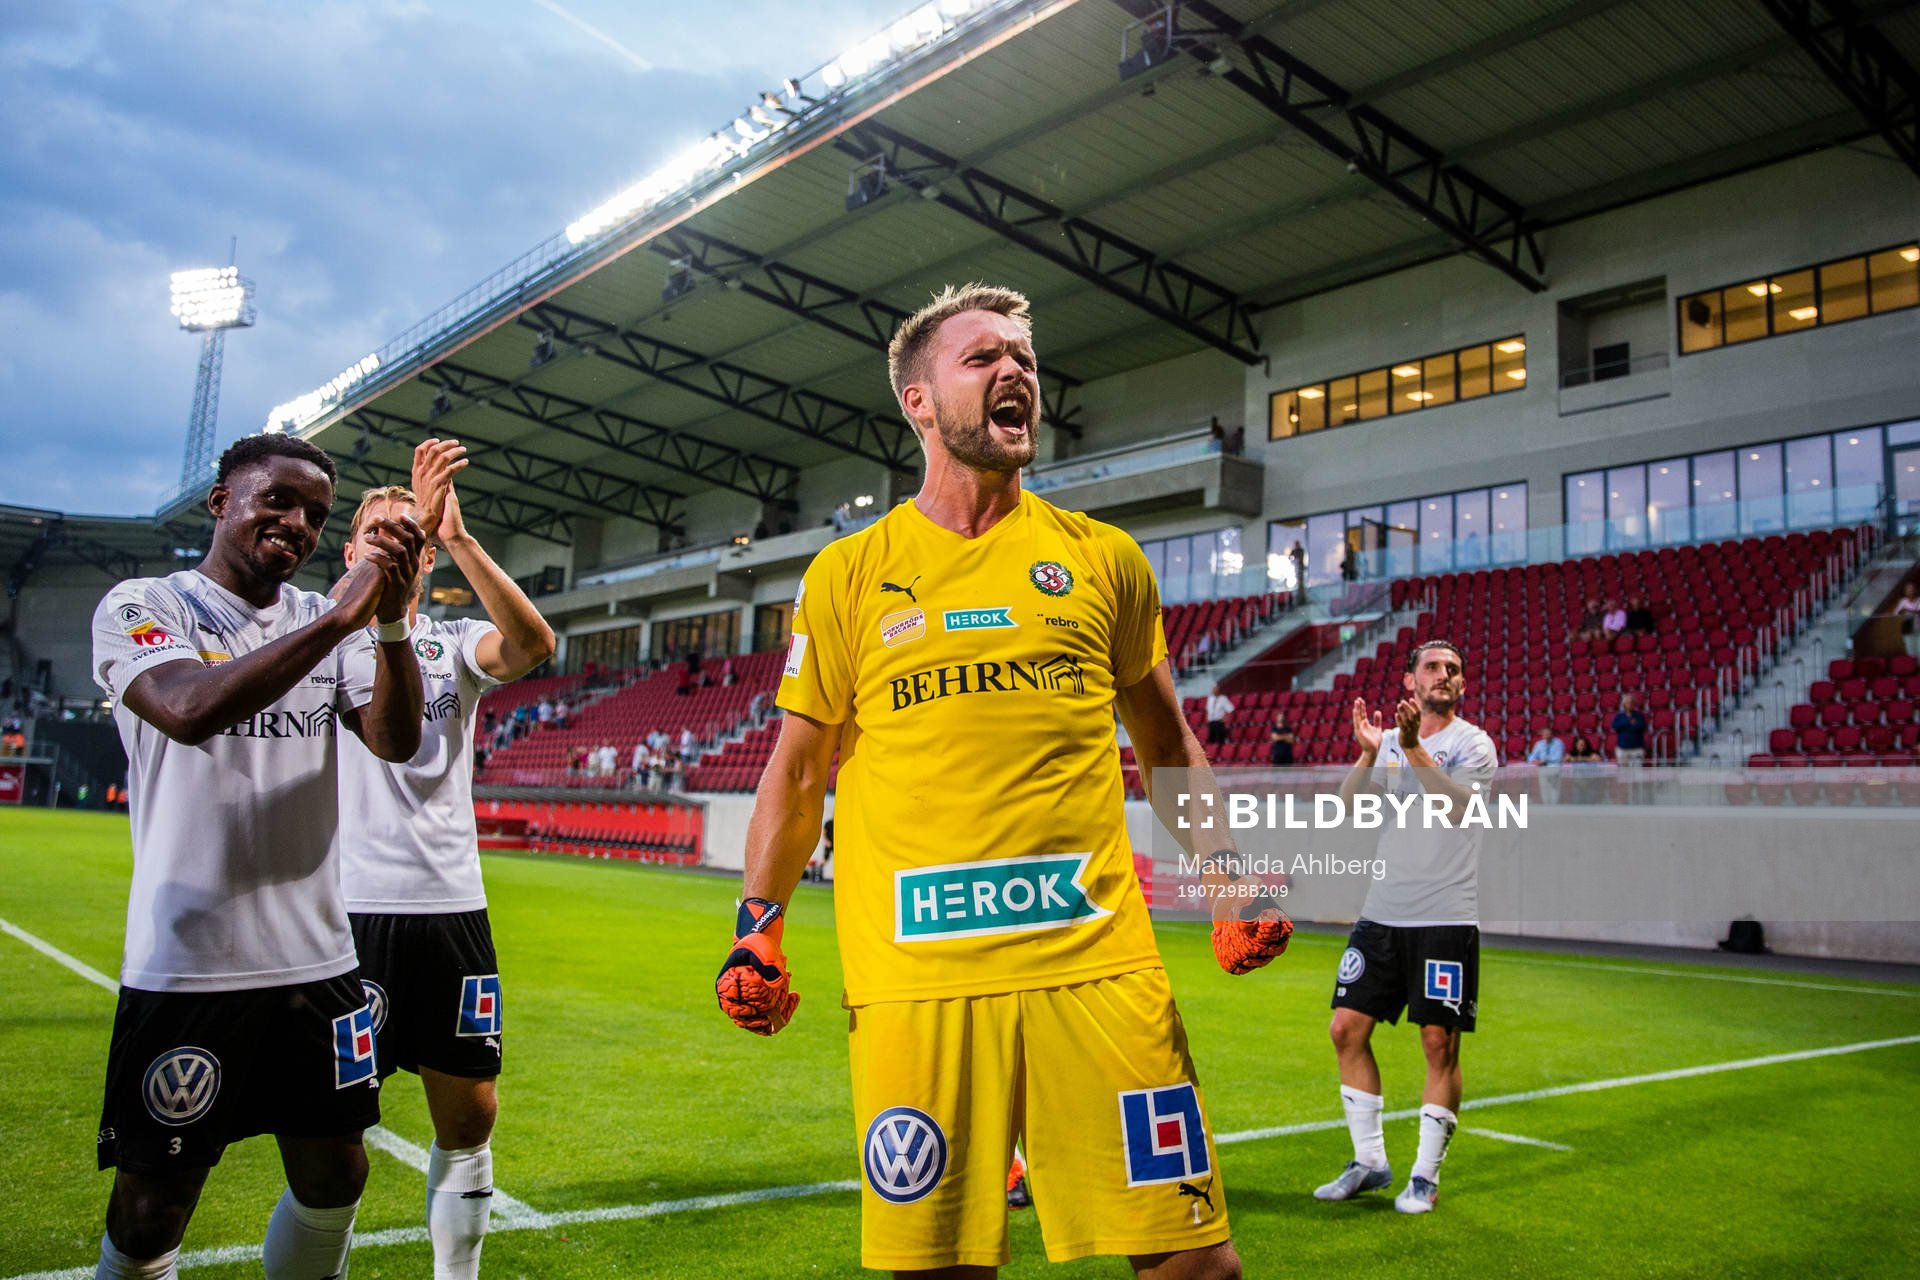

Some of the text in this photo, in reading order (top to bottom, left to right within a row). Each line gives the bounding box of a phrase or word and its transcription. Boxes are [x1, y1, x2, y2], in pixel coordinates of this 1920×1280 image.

[950, 612, 1003, 626] HEROK
[132, 644, 174, 661] SVENSKA
[889, 661, 1038, 712] BEHRN
[216, 711, 308, 738] HRN
[913, 873, 1070, 923] HEROK
[751, 904, 779, 932] uhlsport
[168, 1136, 182, 1155] 3
[1192, 1201, 1202, 1224] 1
